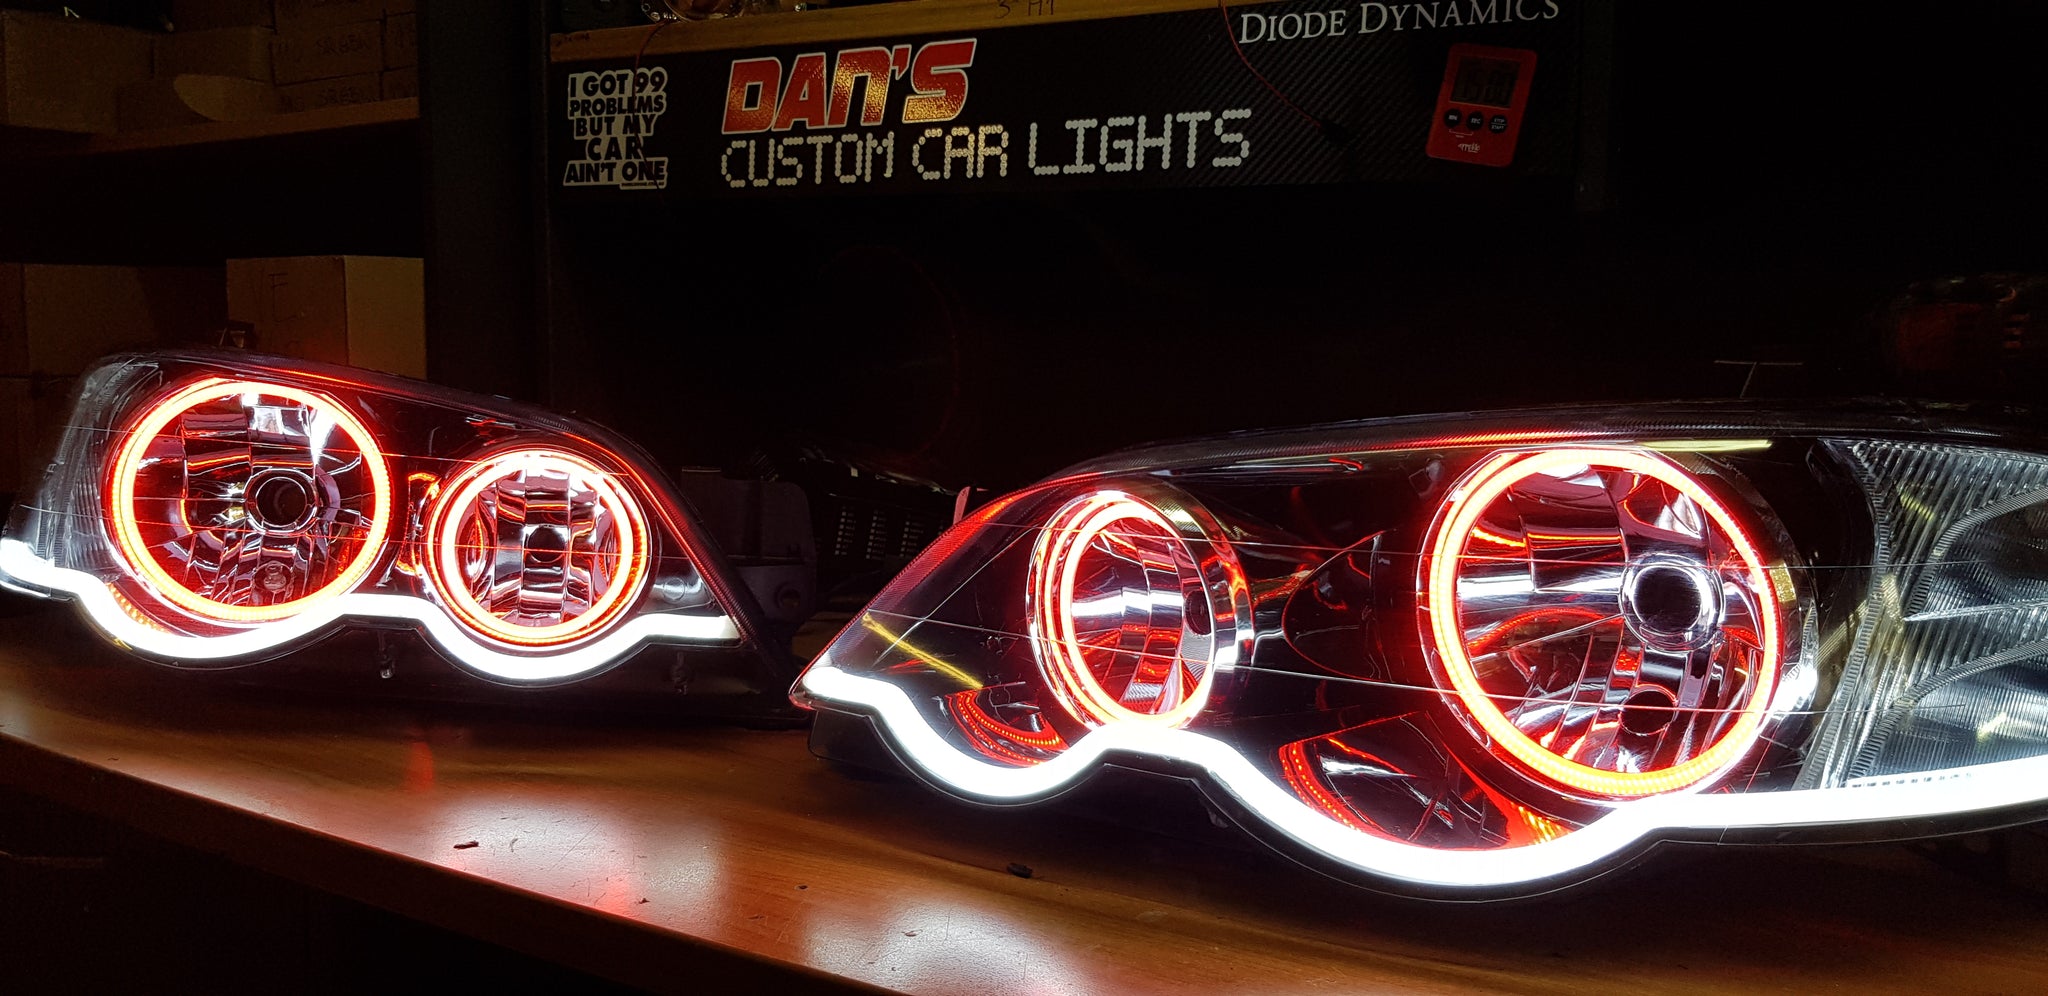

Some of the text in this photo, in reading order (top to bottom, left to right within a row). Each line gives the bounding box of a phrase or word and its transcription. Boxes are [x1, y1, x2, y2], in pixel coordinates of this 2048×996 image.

[1239, 0, 1559, 44] DIODE DYNAMICS
[570, 71, 665, 97] I GOT 99
[722, 38, 977, 134] DAN'S
[570, 95, 664, 116] PROBLEMS
[576, 113, 656, 136] BUT MY
[587, 137, 644, 160] CAR
[721, 108, 1252, 188] CUSTOM CAR LIGHTS
[565, 160, 665, 182] AIN'T ONE
